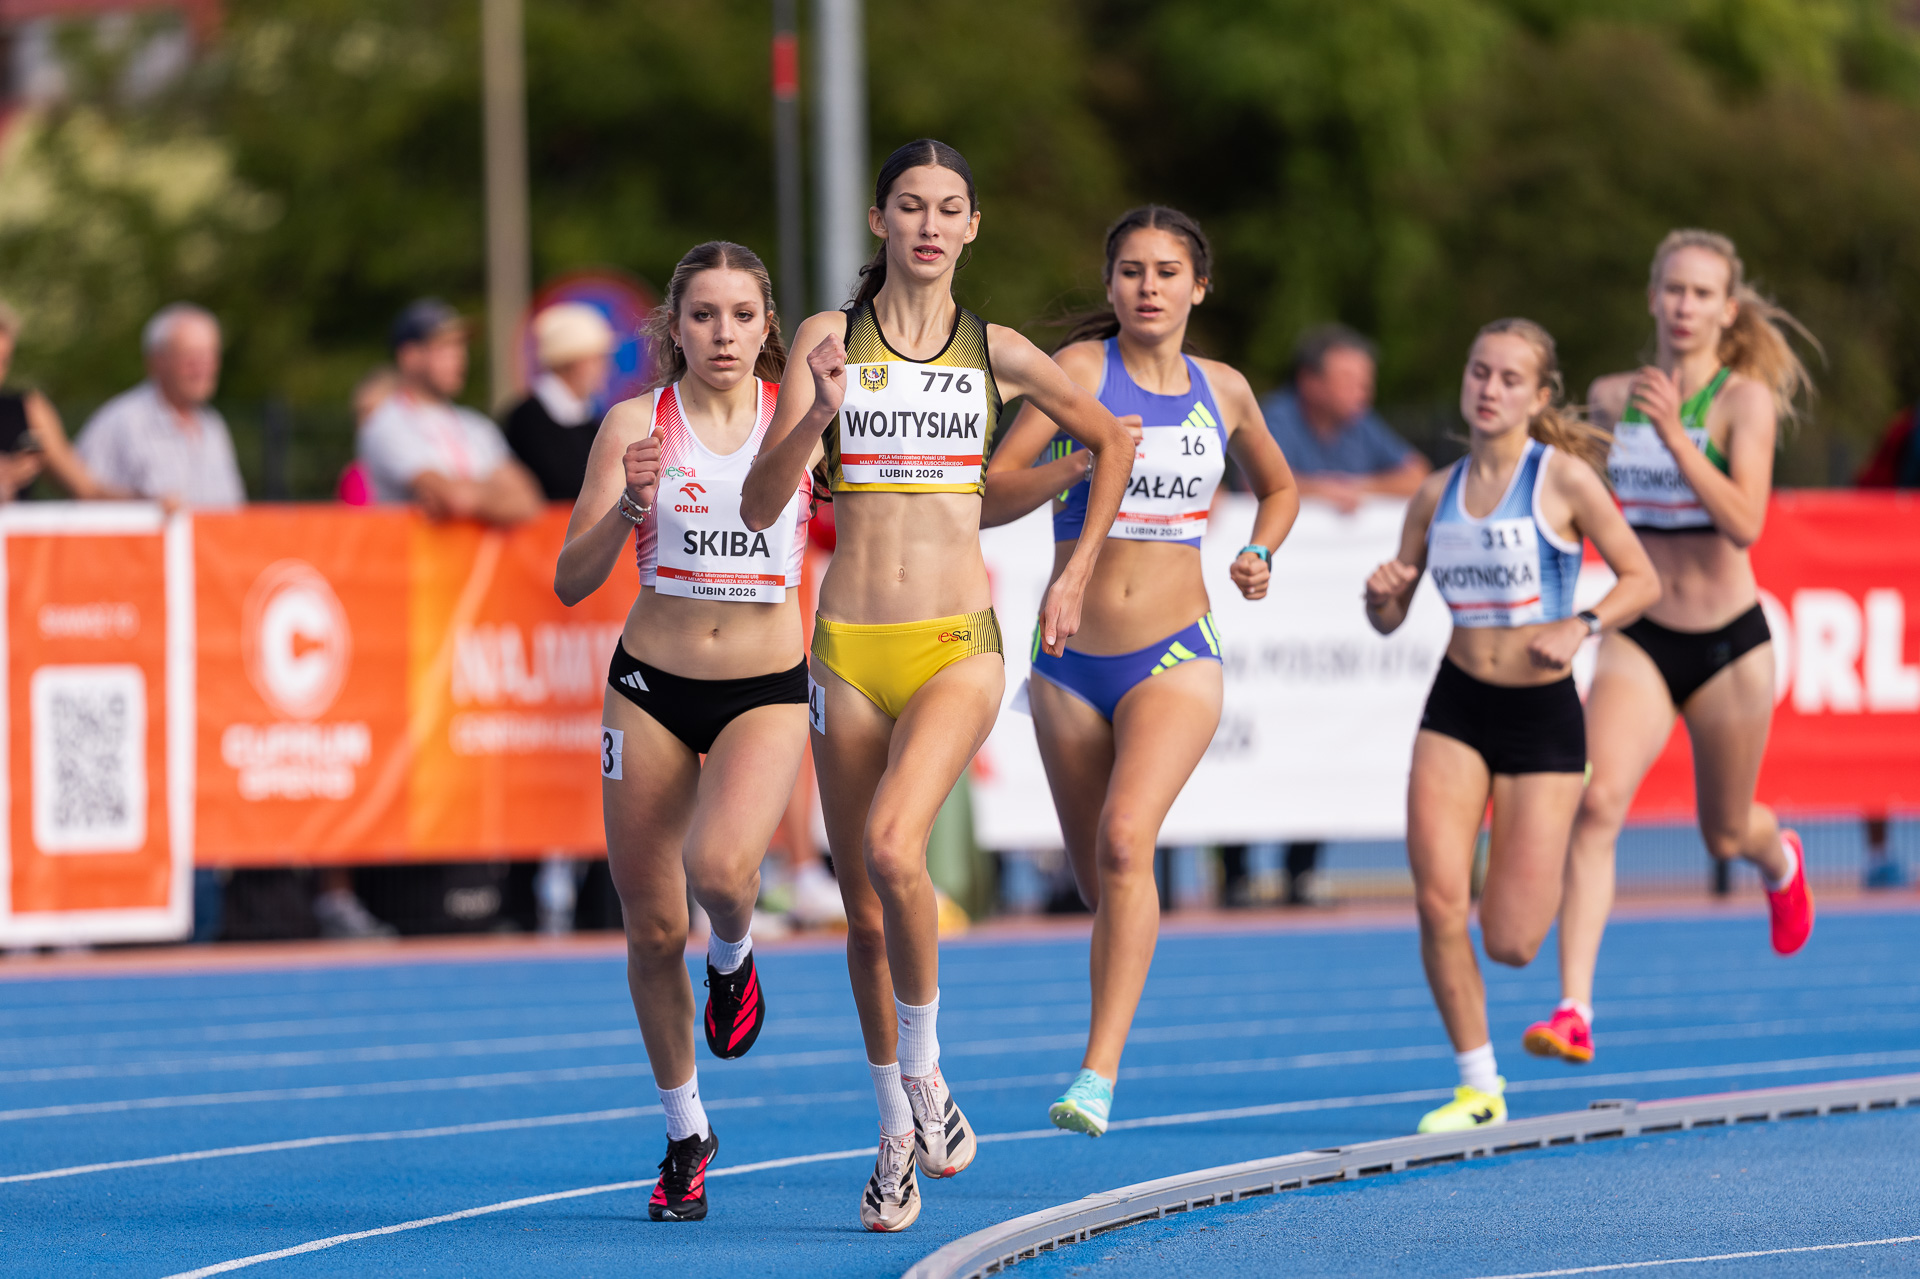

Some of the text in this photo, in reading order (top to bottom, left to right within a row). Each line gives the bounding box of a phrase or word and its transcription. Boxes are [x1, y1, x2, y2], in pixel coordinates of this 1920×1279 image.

[921, 371, 972, 394] 776
[845, 411, 979, 438] WOJTYSIAK
[1181, 435, 1205, 456] 16
[879, 469, 943, 478] LUBIN 2026
[674, 504, 709, 514] ORLEN
[1125, 526, 1157, 536] LUBIN
[1481, 528, 1521, 549] 311
[683, 530, 770, 558] SKIBA
[692, 586, 757, 597] LUBIN 2026
[809, 685, 820, 726] 4
[602, 731, 614, 774] 3
